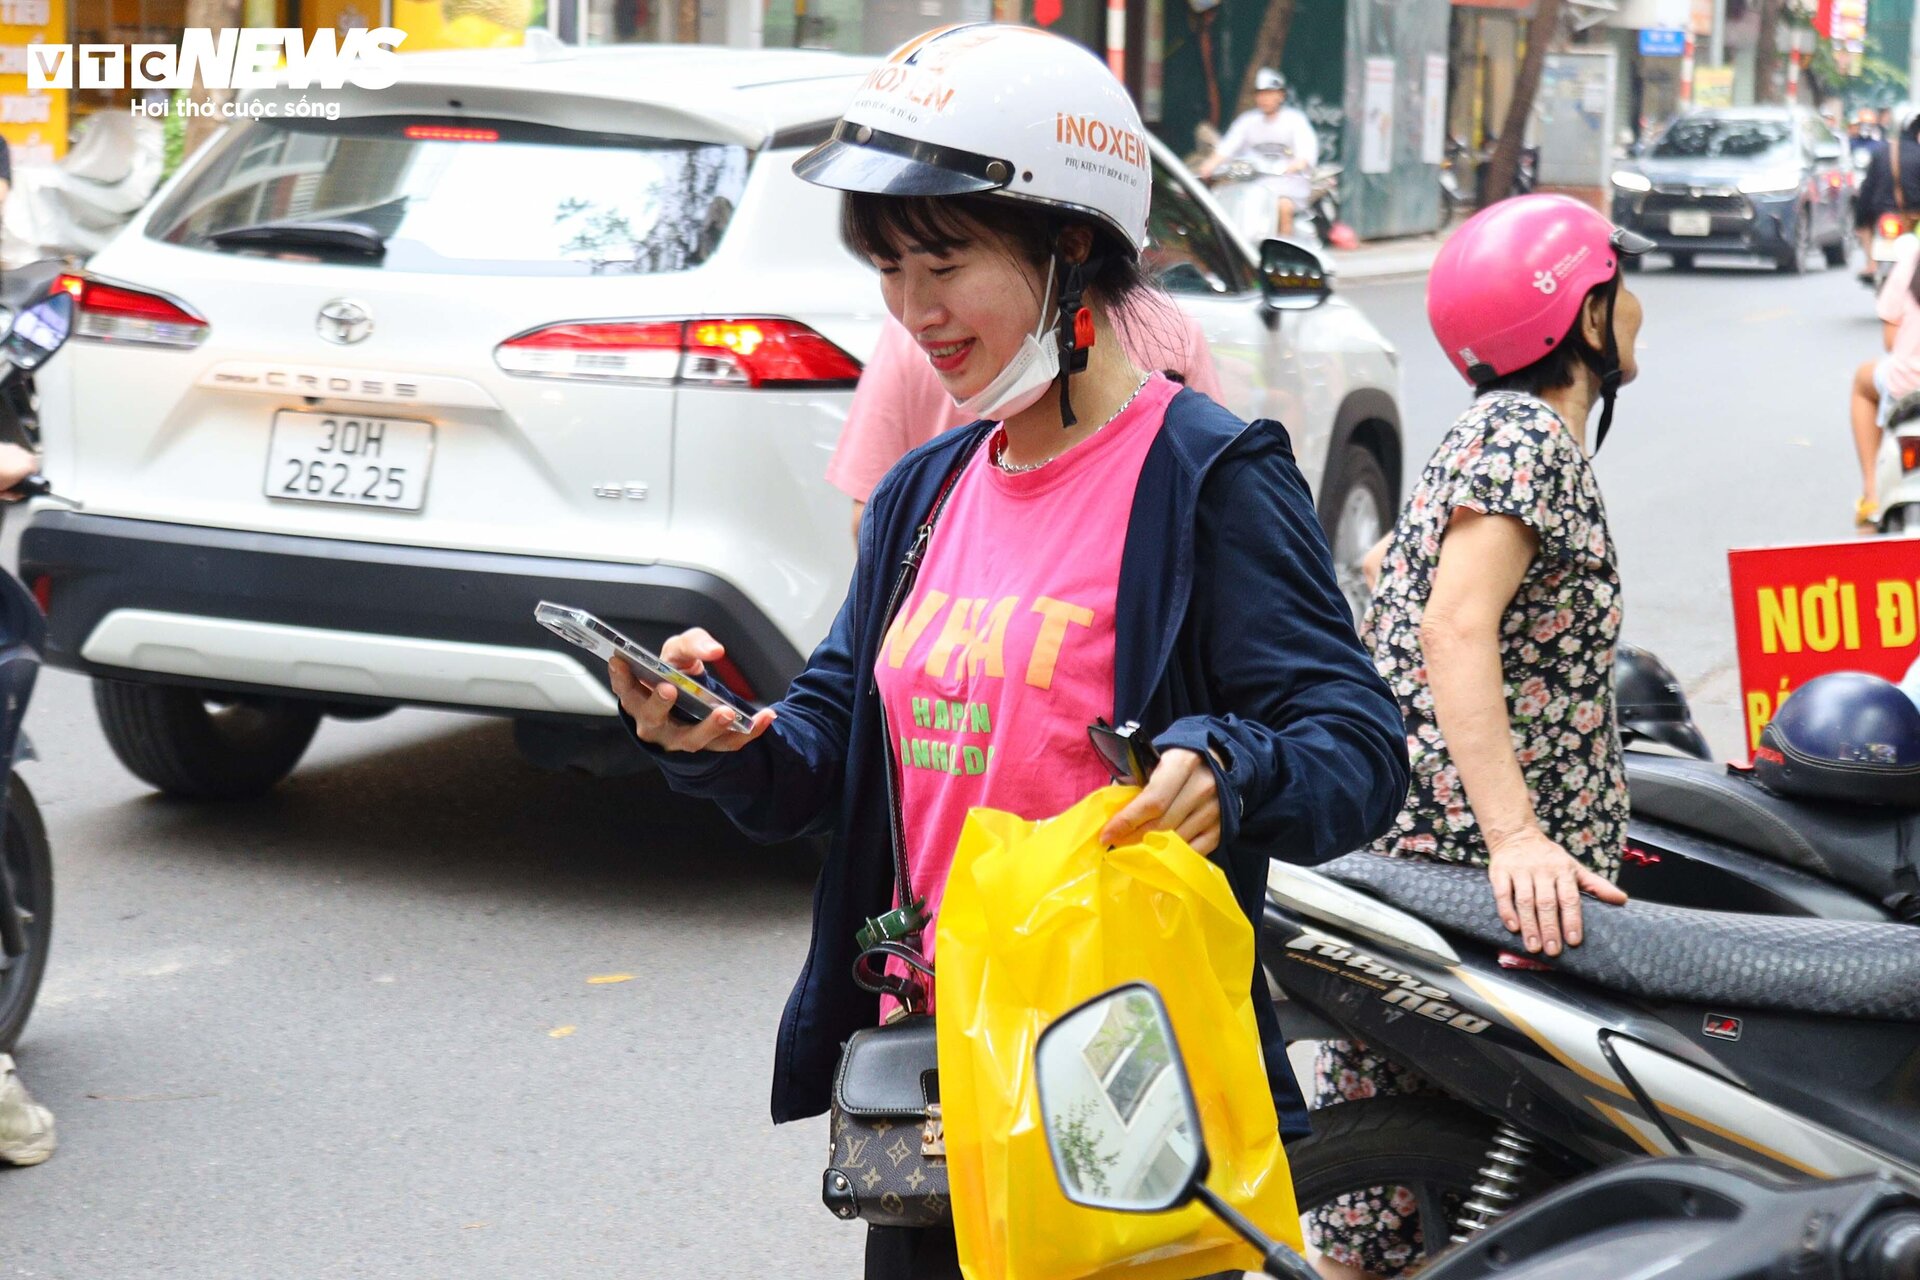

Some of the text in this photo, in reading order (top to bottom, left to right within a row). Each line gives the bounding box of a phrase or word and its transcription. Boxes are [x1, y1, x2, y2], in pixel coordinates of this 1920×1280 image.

[317, 419, 385, 457] 30H
[283, 458, 407, 501] 262.25
[1757, 576, 1920, 654] NƠI Đ
